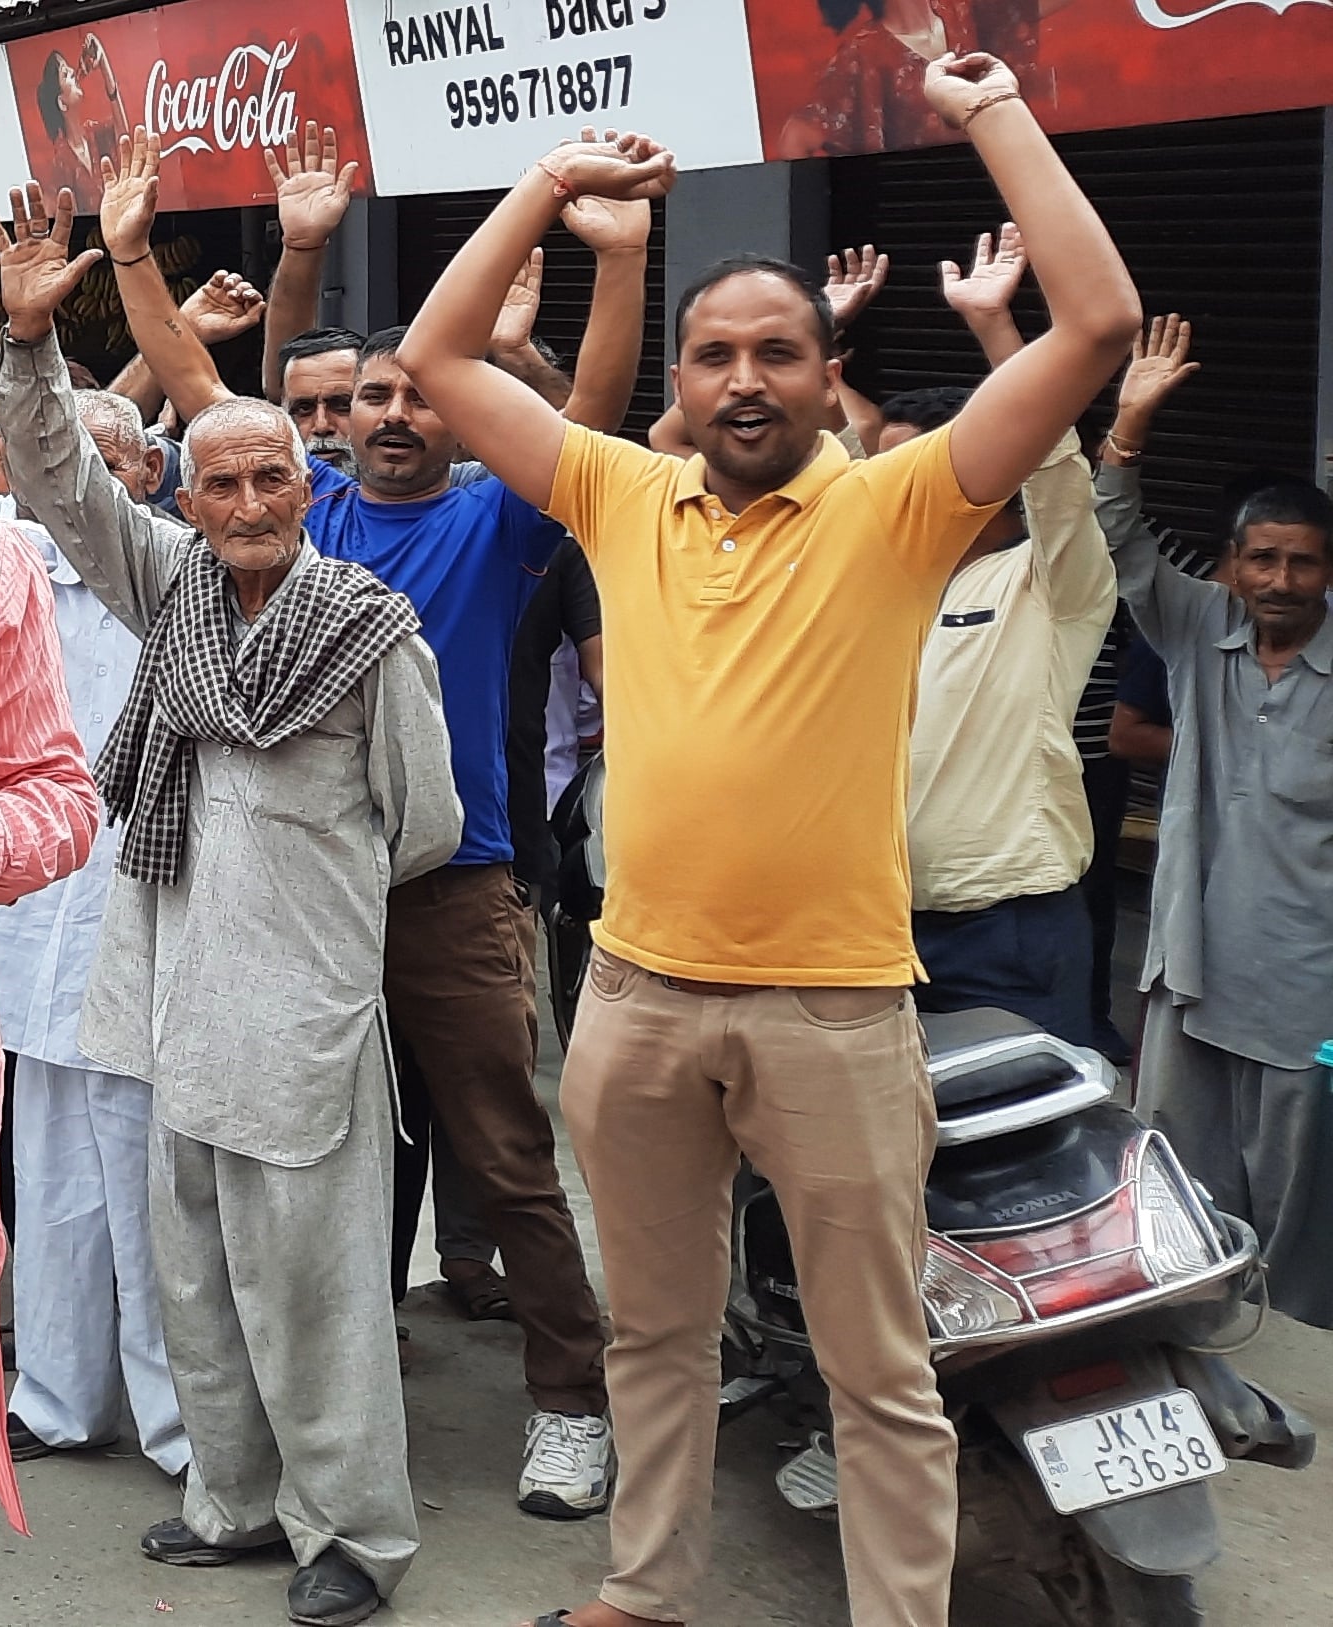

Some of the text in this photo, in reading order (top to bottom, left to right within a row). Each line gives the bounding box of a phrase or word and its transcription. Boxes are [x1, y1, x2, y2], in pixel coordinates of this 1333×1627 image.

[386, 3, 504, 66] RANYAL
[145, 36, 299, 159] Coca-Cola
[446, 55, 632, 129] 9596718877
[990, 1190, 1082, 1222] HONDA
[1095, 1401, 1180, 1453] JK14
[1095, 1436, 1211, 1495] E3638
